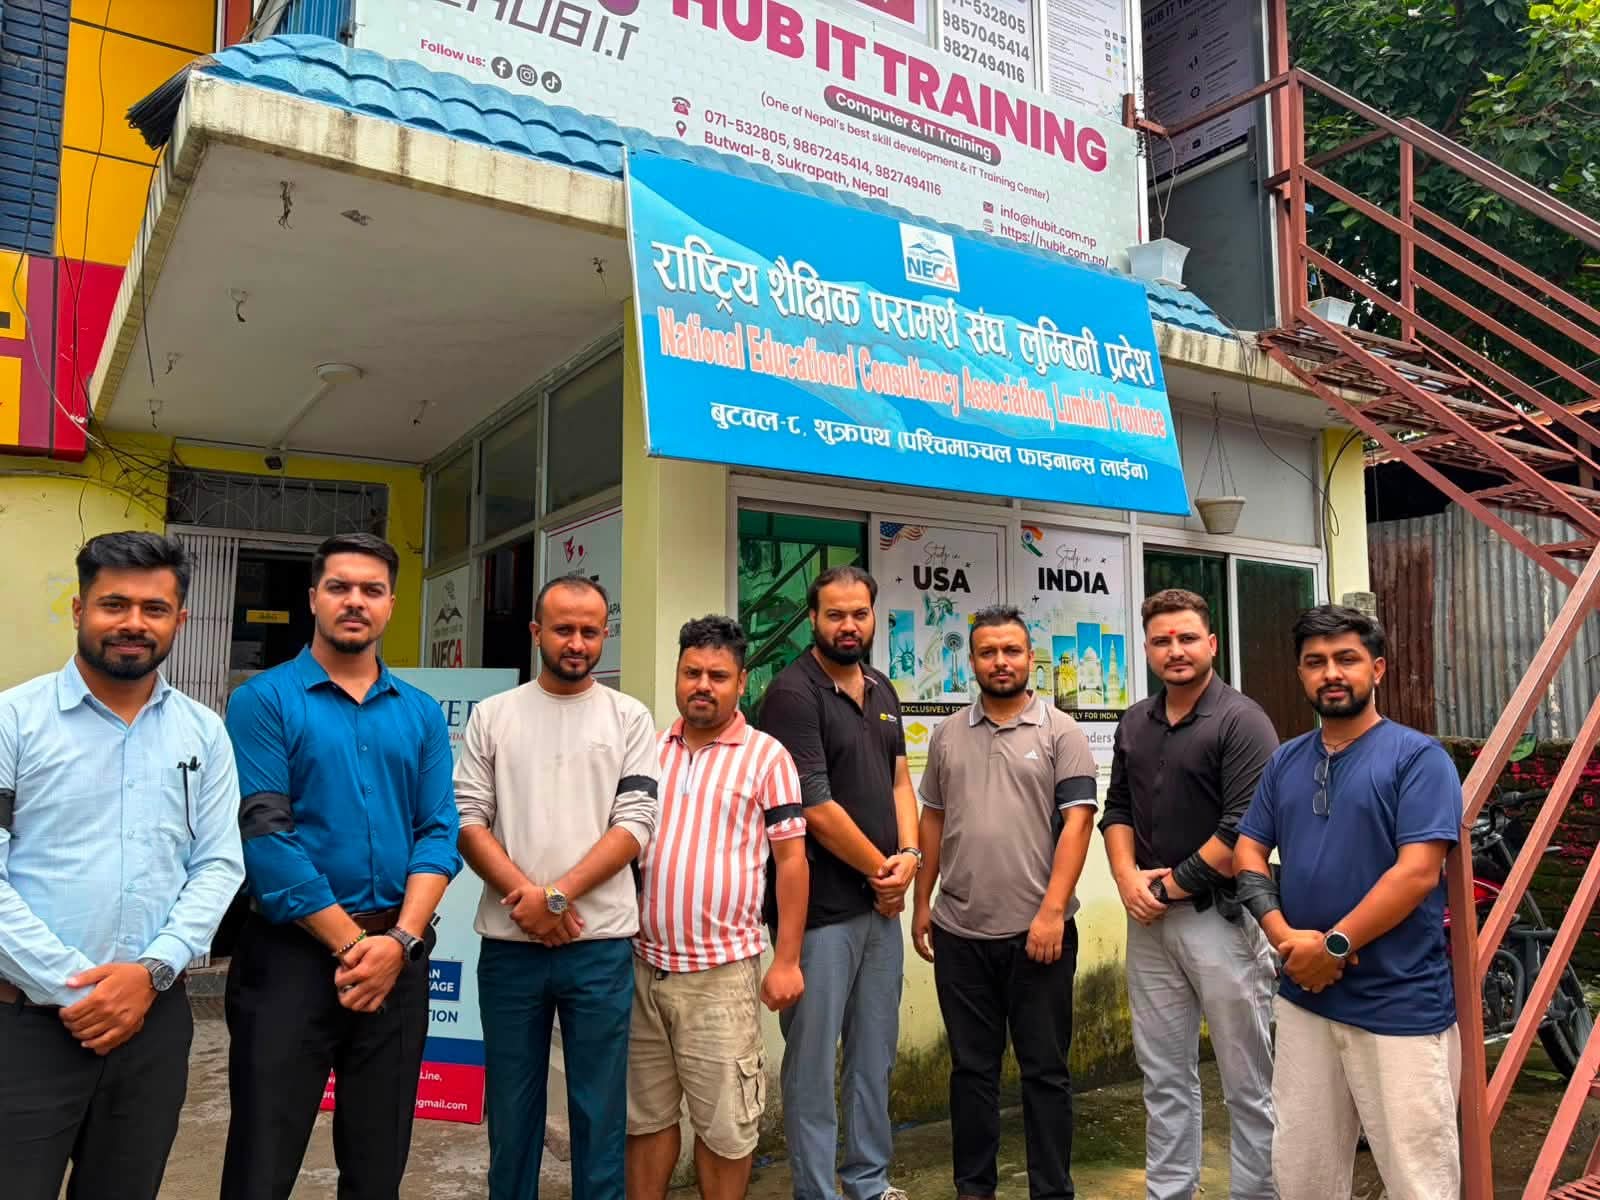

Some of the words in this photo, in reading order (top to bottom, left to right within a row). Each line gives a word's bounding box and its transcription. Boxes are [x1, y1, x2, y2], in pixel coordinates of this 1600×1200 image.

[420, 39, 464, 61] Follow
[466, 51, 486, 68] us:
[943, 10, 1030, 62] 9857045414
[943, 36, 1025, 84] 9827494116
[815, 18, 867, 81] IT
[873, 42, 1107, 172] TRAINING
[761, 90, 790, 112] (One
[791, 104, 804, 117] of
[804, 108, 845, 131] Nepal's
[847, 121, 871, 138] best
[872, 131, 892, 147] skill
[892, 139, 959, 170] development
[960, 161, 968, 173] &
[968, 164, 979, 177] IT
[979, 167, 1016, 192] Training
[1017, 181, 1050, 202] Center)
[835, 91, 909, 128] Computer
[911, 118, 922, 133] &
[924, 123, 936, 138] IT
[937, 127, 992, 161] Training
[704, 109, 790, 149] 071-532805,
[793, 137, 873, 176] 9867245414,
[875, 164, 942, 196] 9827494116
[704, 130, 774, 165] Butwal-8,
[776, 152, 850, 188] Sukrapath,
[852, 175, 889, 198] Nepal
[1000, 203, 1097, 250] info@hubit.com.np
[907, 255, 957, 286] NECA
[651, 234, 760, 315] राष्ट्रिय
[767, 254, 861, 329] शैक्षिक
[867, 290, 961, 351] परामर्श
[1016, 314, 1102, 377] लुम्बिनी
[1103, 333, 1156, 387] प्रदेश
[656, 305, 746, 370] National
[746, 323, 858, 391] Educational
[858, 345, 961, 418] Consultancy
[962, 365, 1055, 431] Association,
[1055, 383, 1109, 431] Lumbini
[1109, 391, 1167, 439] Province
[813, 418, 891, 446] शुक्रपथ
[1016, 446, 1096, 475] फाइनान्स
[922, 541, 950, 567] Study
[1055, 543, 1082, 570] Study
[912, 565, 971, 593] USA
[1037, 567, 1110, 595] INDIA
[431, 639, 464, 668] NECA
[901, 705, 951, 713] EXCLUSIVELY
[1084, 711, 1098, 720] FOR
[1099, 711, 1118, 720] INDIA
